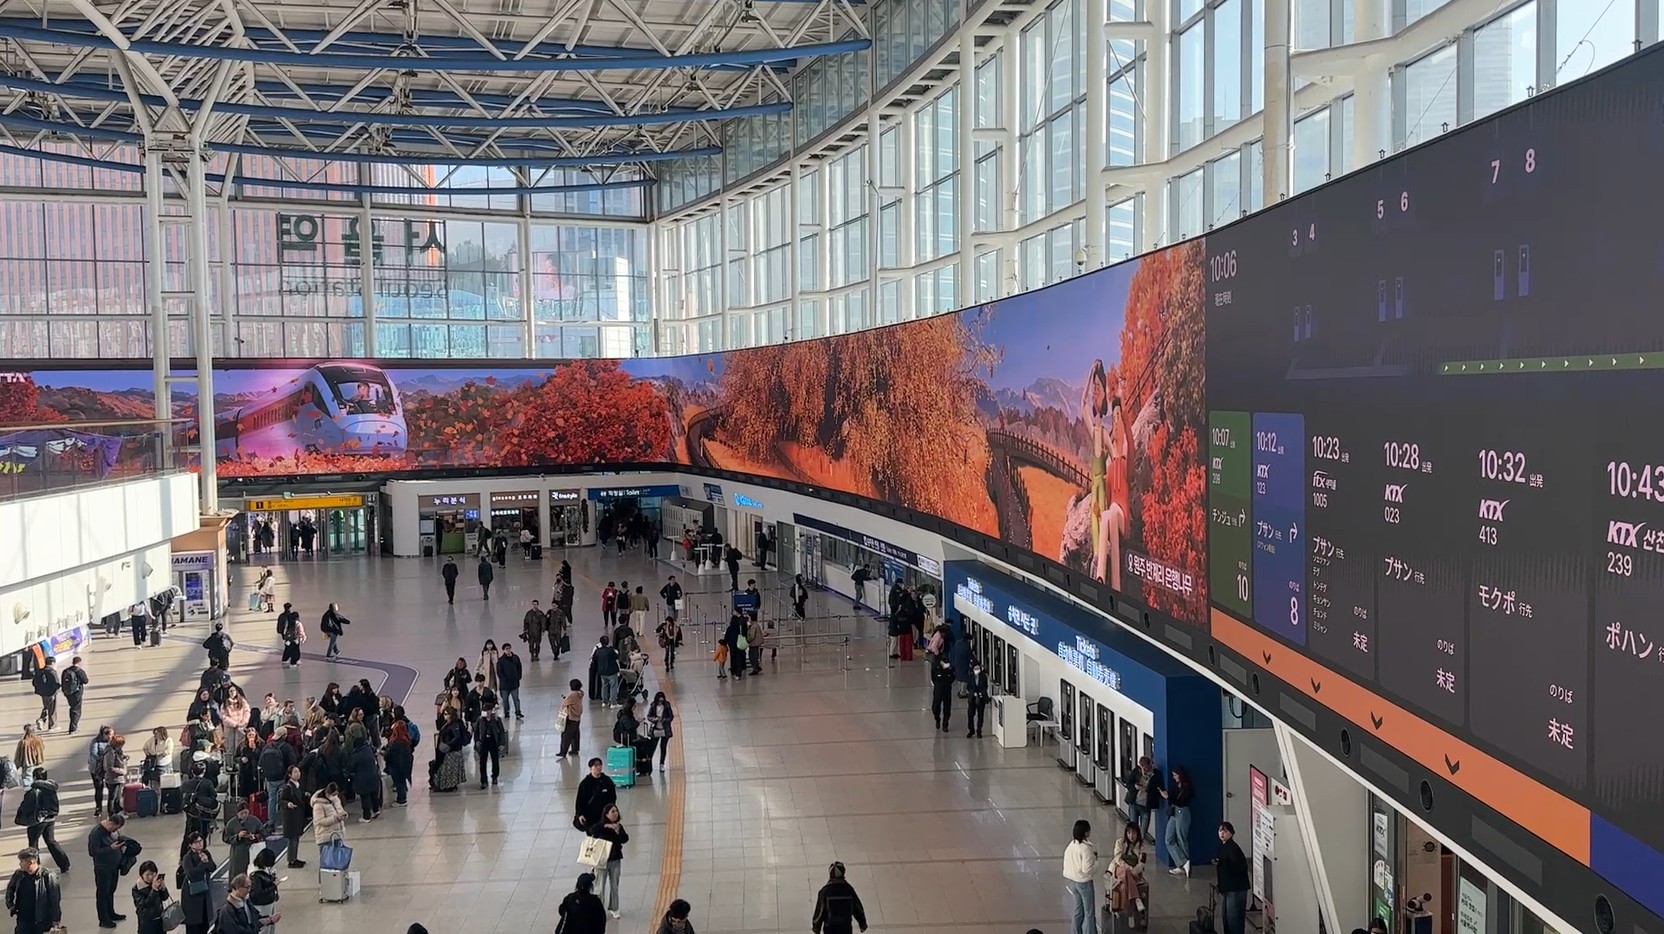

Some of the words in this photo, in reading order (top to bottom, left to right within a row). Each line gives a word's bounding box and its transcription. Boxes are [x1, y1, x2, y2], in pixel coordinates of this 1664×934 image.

[1491, 159, 1500, 184] 7
[1525, 148, 1536, 173] 8
[1377, 200, 1384, 219] 5
[1400, 191, 1408, 212] 6
[1292, 229, 1298, 246] 3
[1309, 223, 1315, 240] 4
[1210, 249, 1237, 282] 10:06
[1212, 427, 1230, 446] 10:07
[1256, 431, 1277, 452] 10:12
[1312, 435, 1340, 460] 10:23
[1212, 457, 1224, 470] KTX
[1384, 441, 1419, 470] 10:28
[1421, 461, 1432, 474] 出発
[1478, 449, 1526, 483] 10:32
[1529, 473, 1544, 488] 出発
[1257, 464, 1271, 479] KTX
[1607, 461, 1664, 503] 10:43
[1257, 482, 1266, 494] 123
[1313, 492, 1328, 508] 1005
[1385, 483, 1408, 503] KTX
[1385, 506, 1400, 524] 023
[1479, 499, 1511, 522] KTX
[1479, 525, 1498, 545] 413
[1607, 520, 1647, 548] KTX
[171, 556, 208, 564] AMANE
[1385, 557, 1413, 581] プサン
[1414, 571, 1425, 585] 行先
[1607, 551, 1632, 577] 239
[1165, 568, 1193, 596] 은행나무
[1237, 574, 1249, 601] 10
[1290, 596, 1299, 625] 8
[1353, 606, 1367, 619] のりば
[1478, 584, 1516, 615] モクポ
[1518, 602, 1533, 618] 行先
[1353, 631, 1368, 653] 未定
[1436, 639, 1455, 655] のりば
[1606, 622, 1653, 659] ポハン
[1436, 667, 1455, 694] 未定
[1549, 684, 1573, 704] のりば
[1548, 717, 1574, 750] 未定
